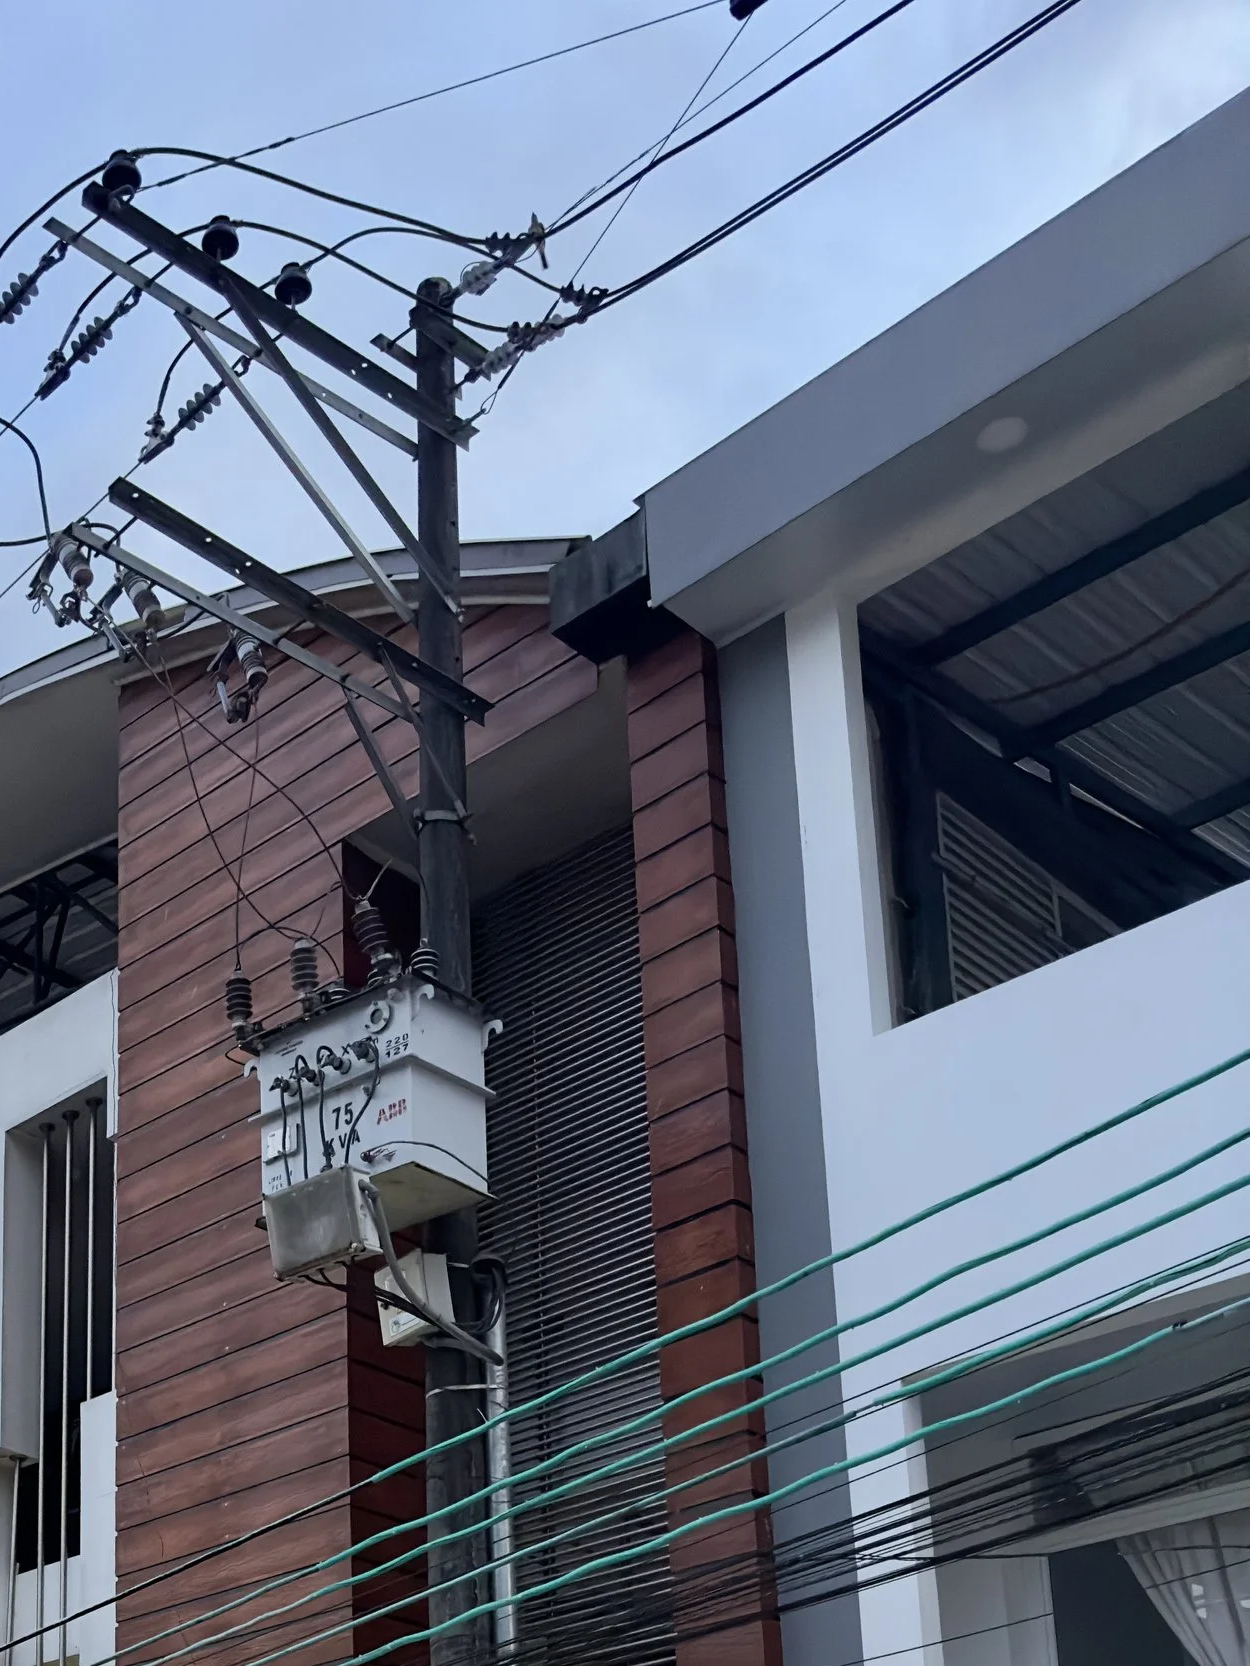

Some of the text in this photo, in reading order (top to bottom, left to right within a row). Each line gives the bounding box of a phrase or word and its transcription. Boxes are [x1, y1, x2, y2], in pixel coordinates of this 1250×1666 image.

[386, 1033, 408, 1048] 220
[385, 1043, 408, 1058] 127
[332, 1102, 354, 1130] 75
